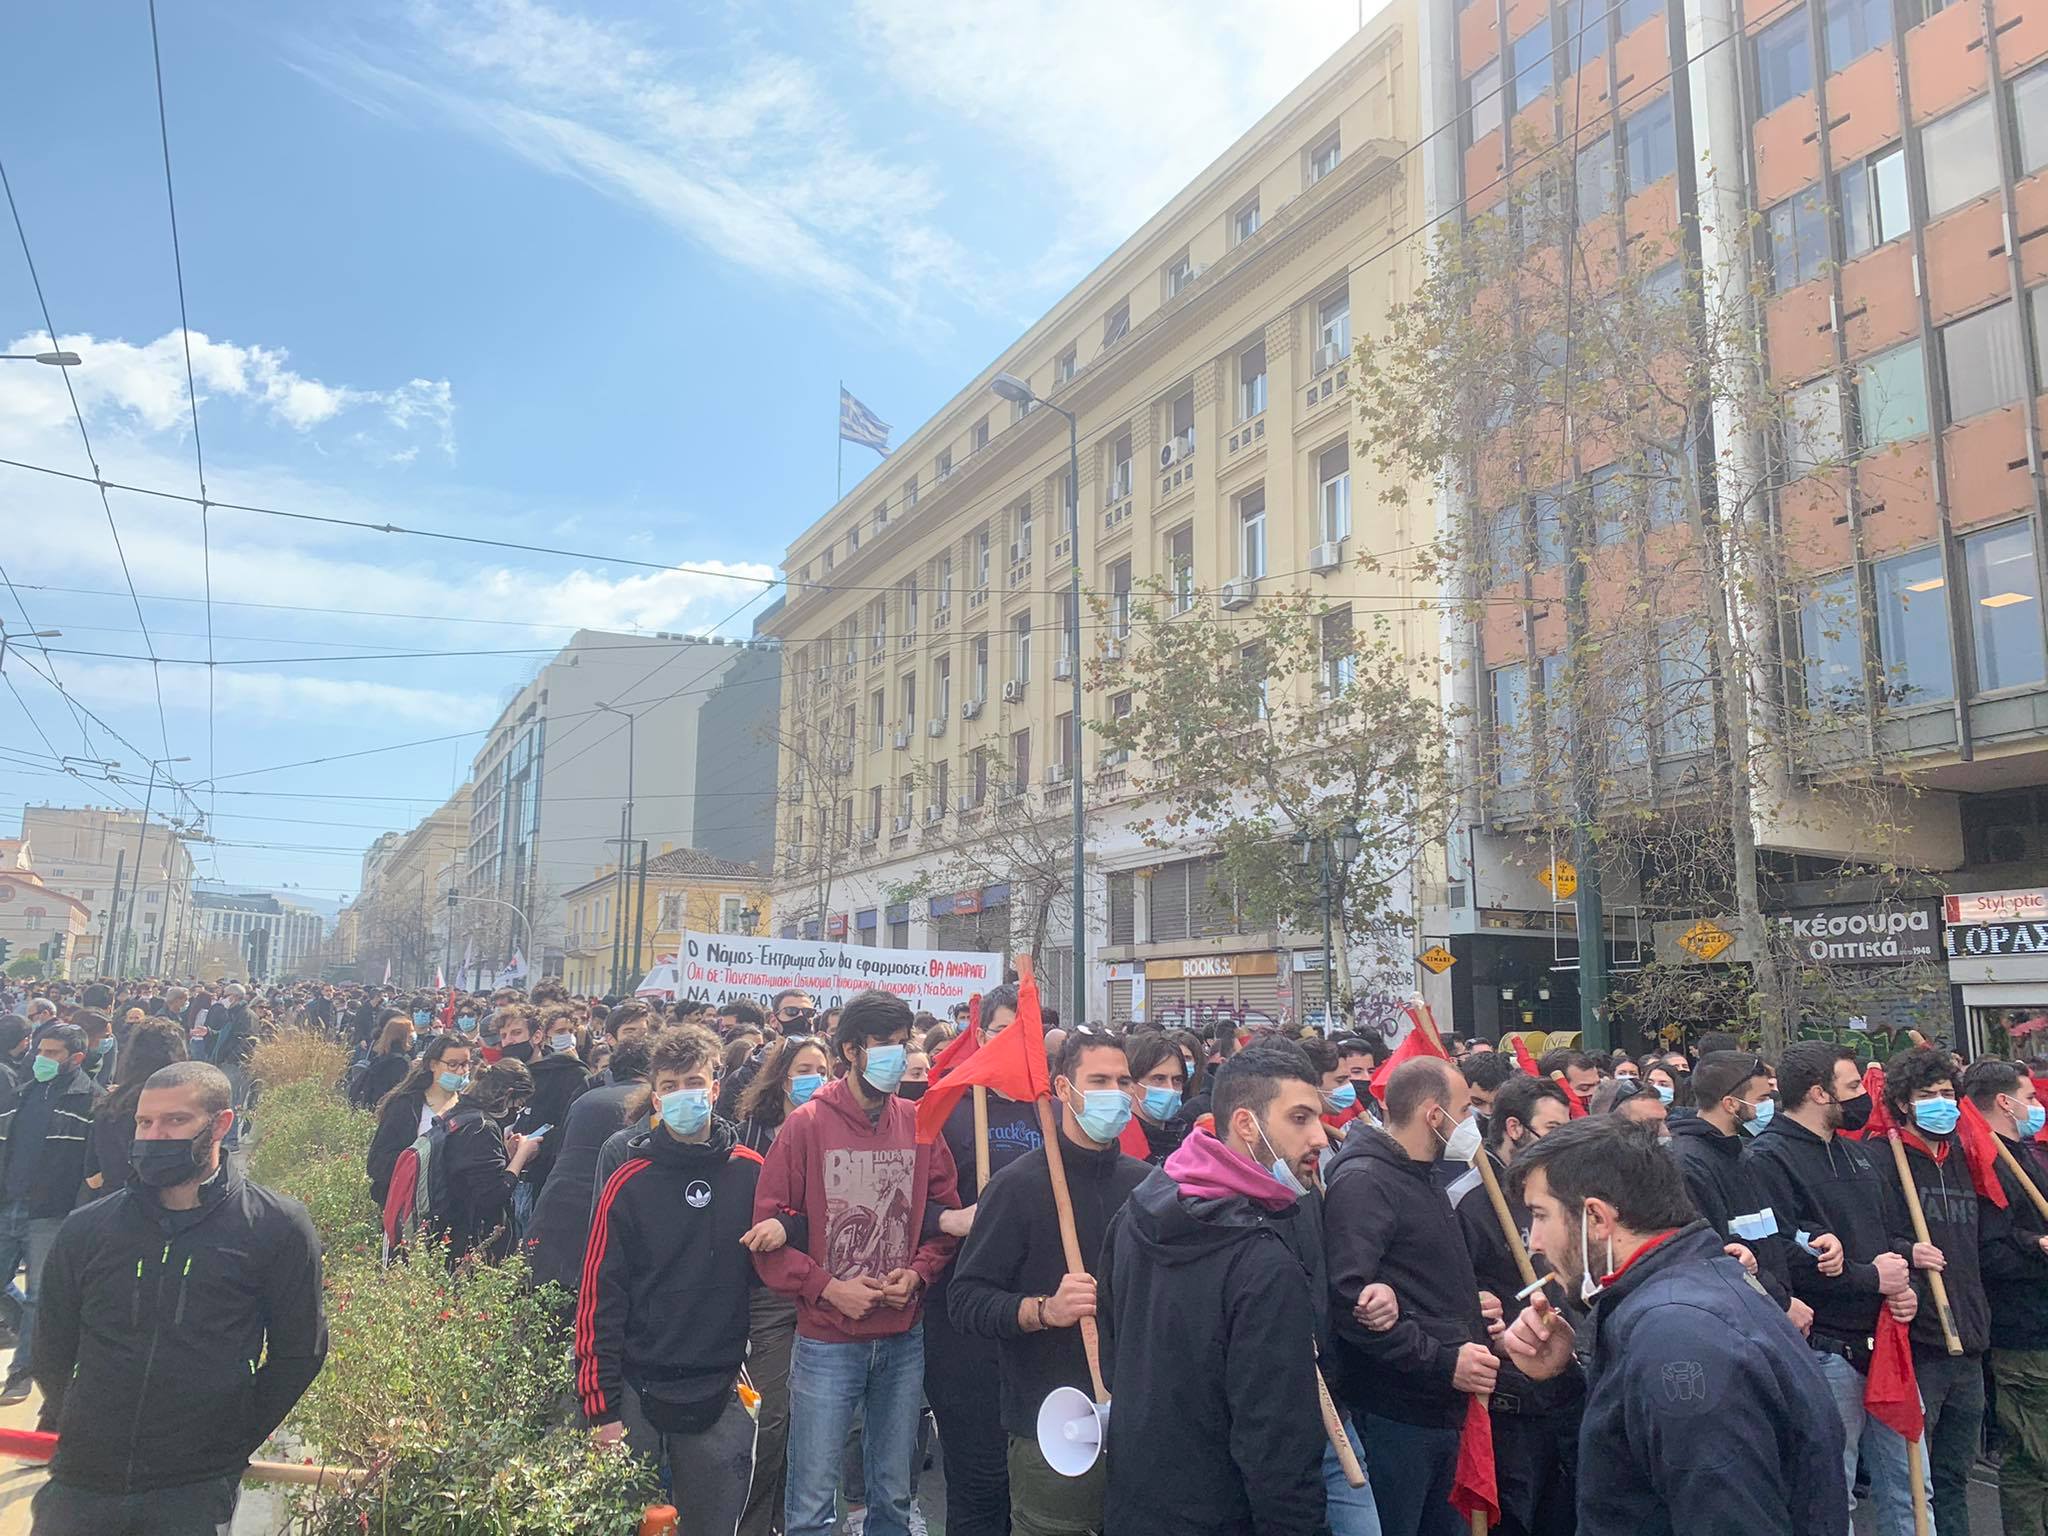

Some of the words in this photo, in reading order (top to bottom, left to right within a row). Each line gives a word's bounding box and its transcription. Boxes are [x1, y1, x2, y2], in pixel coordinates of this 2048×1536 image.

[1809, 937, 1898, 960] Οπτικά
[1912, 945, 1931, 955] 1948
[818, 948, 837, 968] δεν
[839, 951, 852, 970] θα
[929, 959, 944, 979] ΘΑ
[1183, 957, 1221, 977] BOOKS
